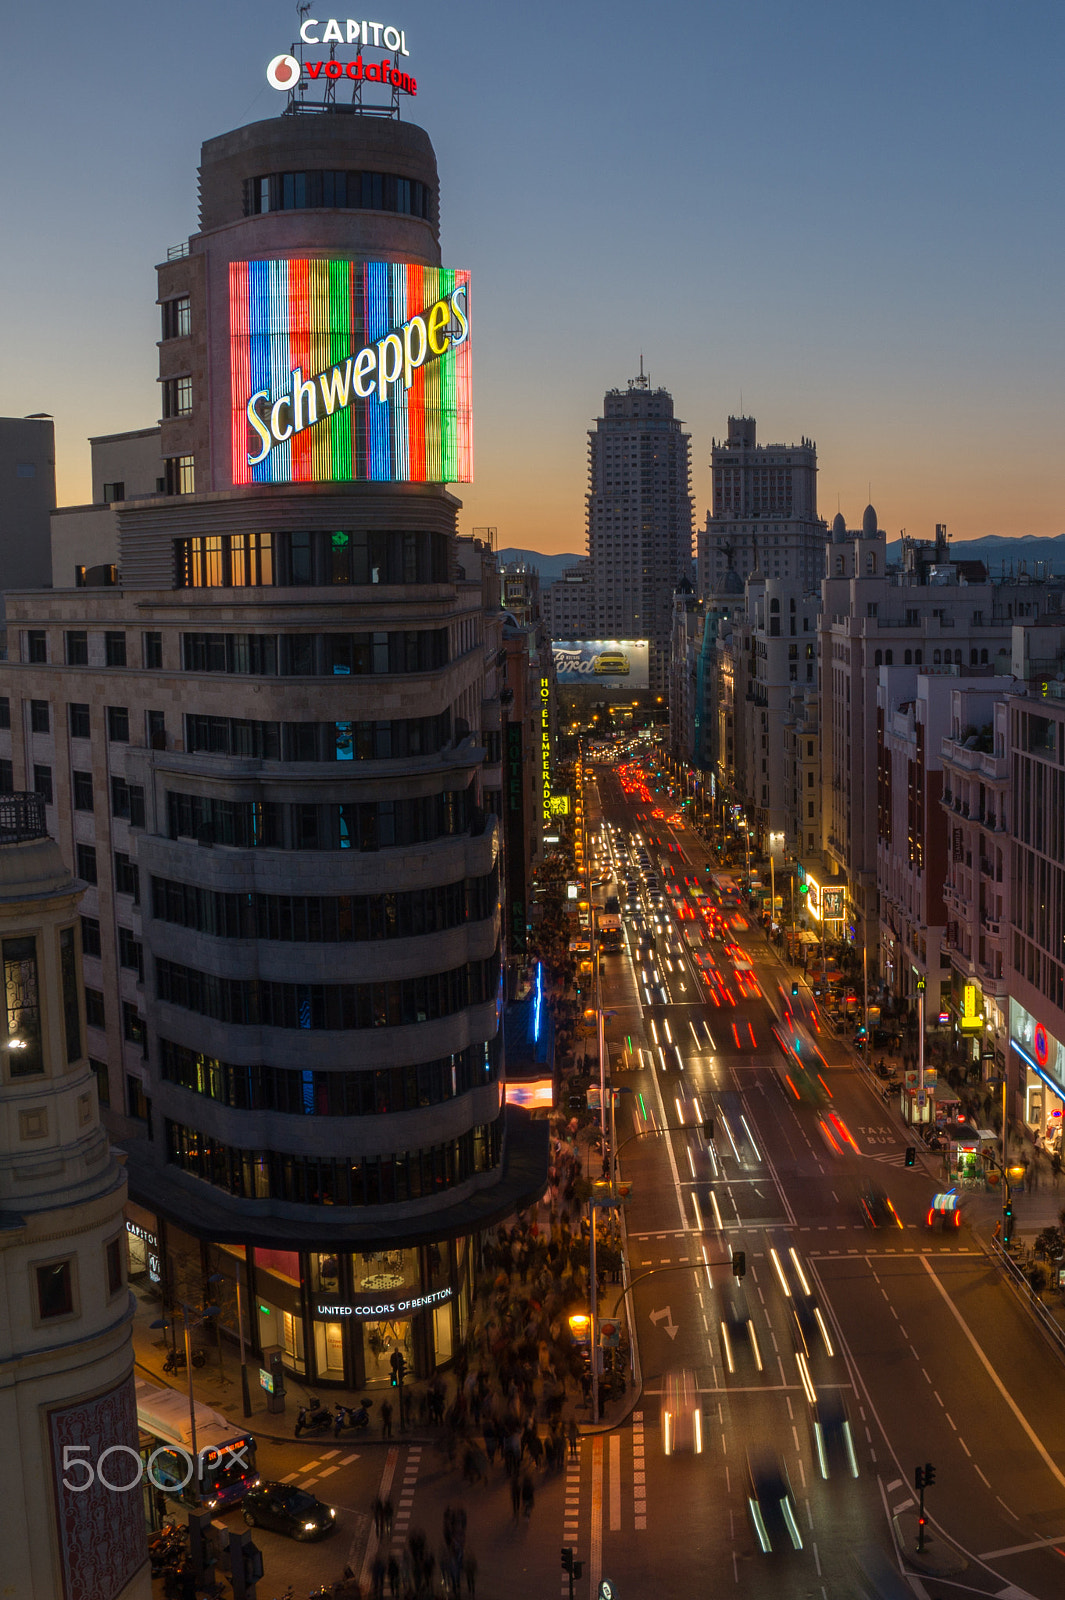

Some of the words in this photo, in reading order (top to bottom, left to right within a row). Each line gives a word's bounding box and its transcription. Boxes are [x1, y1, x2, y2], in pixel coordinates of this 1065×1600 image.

[300, 19, 410, 56] CAPITOL
[305, 55, 417, 96] vodafone
[247, 286, 469, 466] Schweppes
[541, 678, 549, 728] HOTEL
[509, 728, 520, 810] HOTEL
[542, 732, 551, 819] EMPERADOR
[512, 901, 525, 948] REX
[858, 1126, 893, 1134] TAXI
[866, 1136, 896, 1144] BUS
[126, 1221, 158, 1247] CAPITOL
[317, 1305, 353, 1315] UNITED
[355, 1304, 395, 1315] COLORS
[398, 1301, 410, 1311] OF
